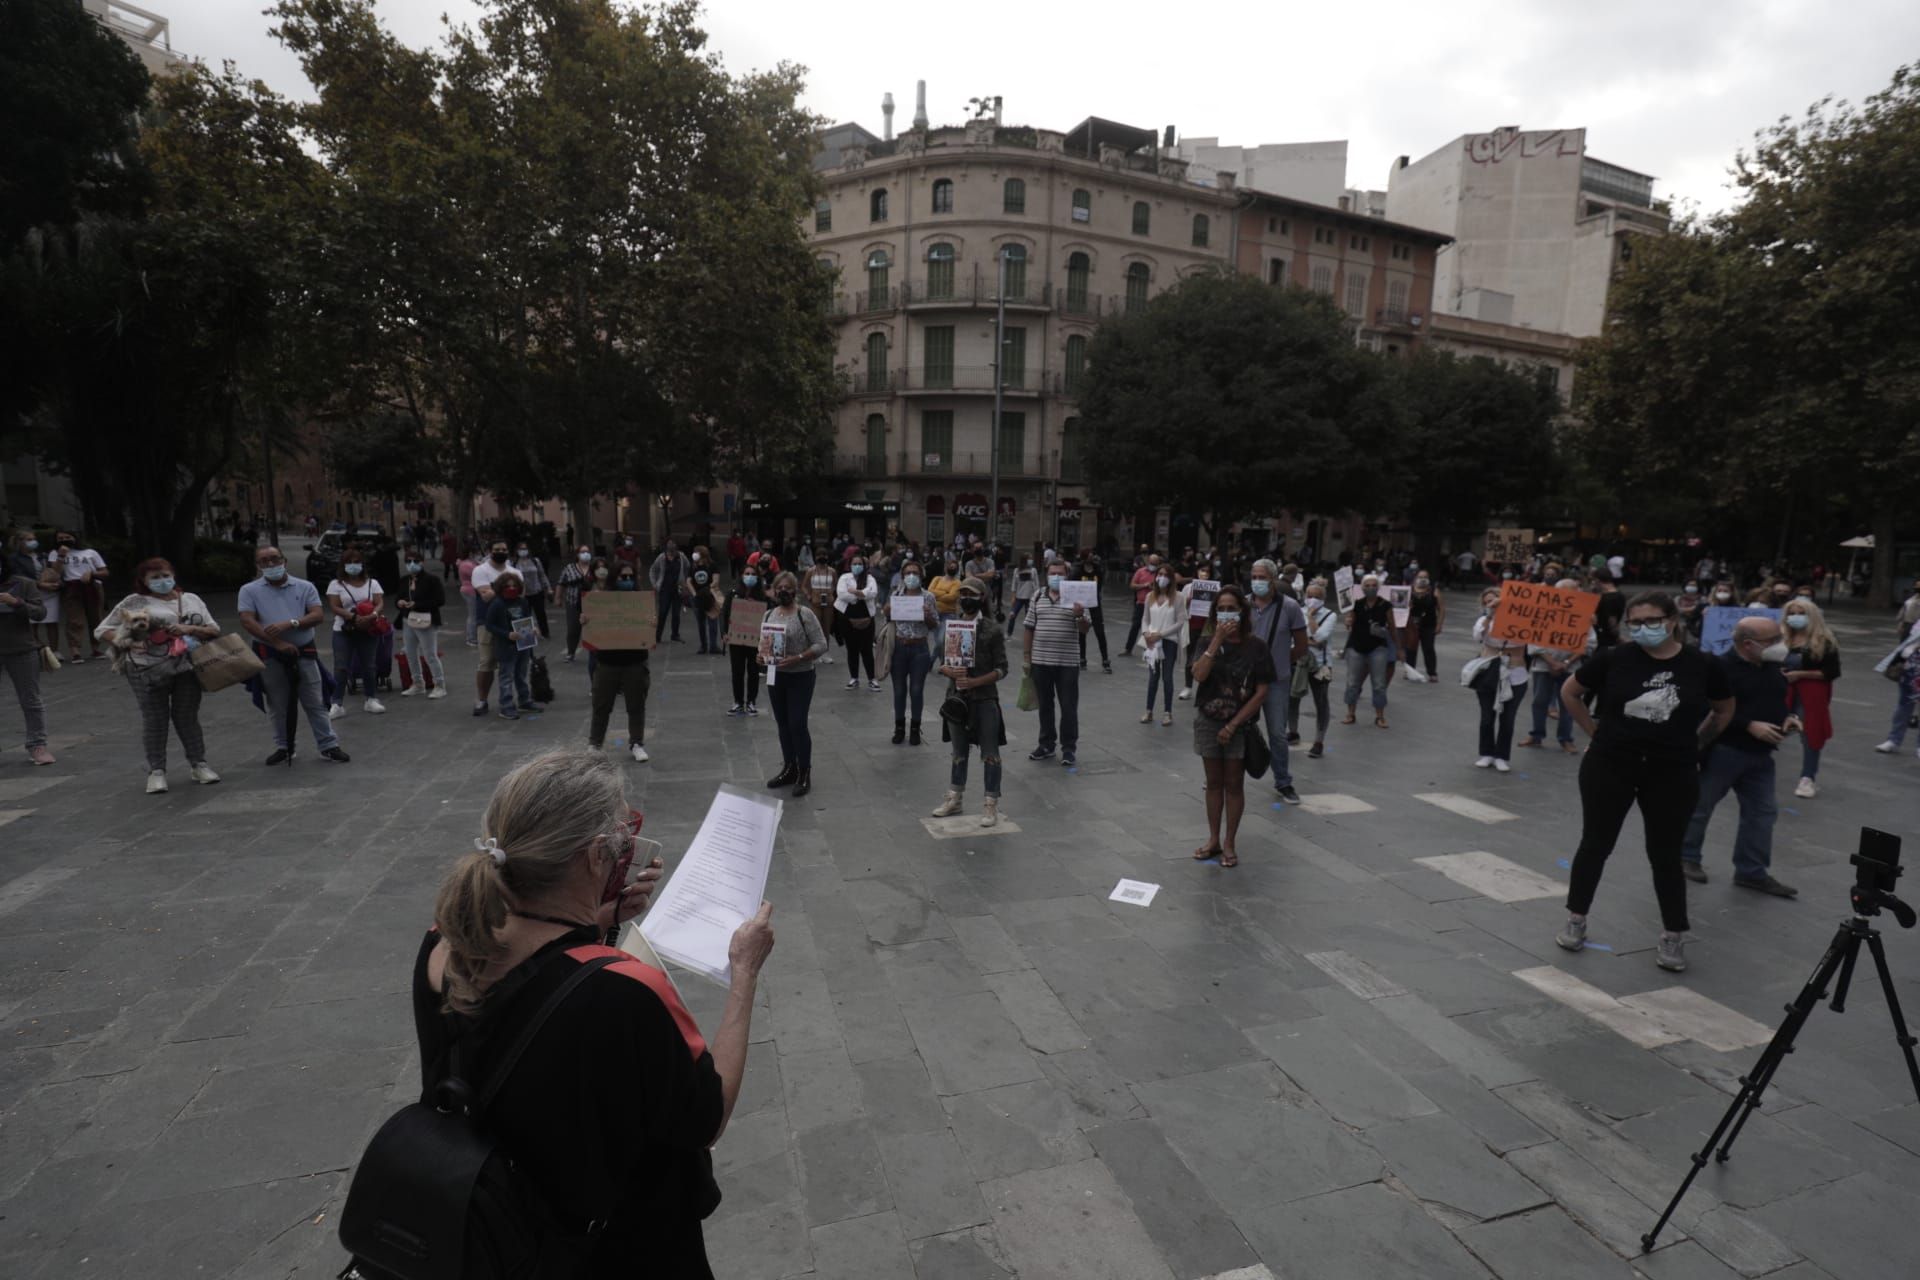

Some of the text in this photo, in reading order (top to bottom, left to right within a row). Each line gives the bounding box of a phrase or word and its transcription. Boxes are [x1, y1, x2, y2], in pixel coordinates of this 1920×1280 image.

[956, 505, 986, 515] KFC
[1060, 510, 1080, 519] KFC
[1193, 581, 1217, 591] BASTA
[1507, 585, 1576, 609] NO MAS
[1508, 603, 1582, 628] MUERTE
[1530, 619, 1549, 629] EN
[1502, 625, 1587, 649] SON REUS
